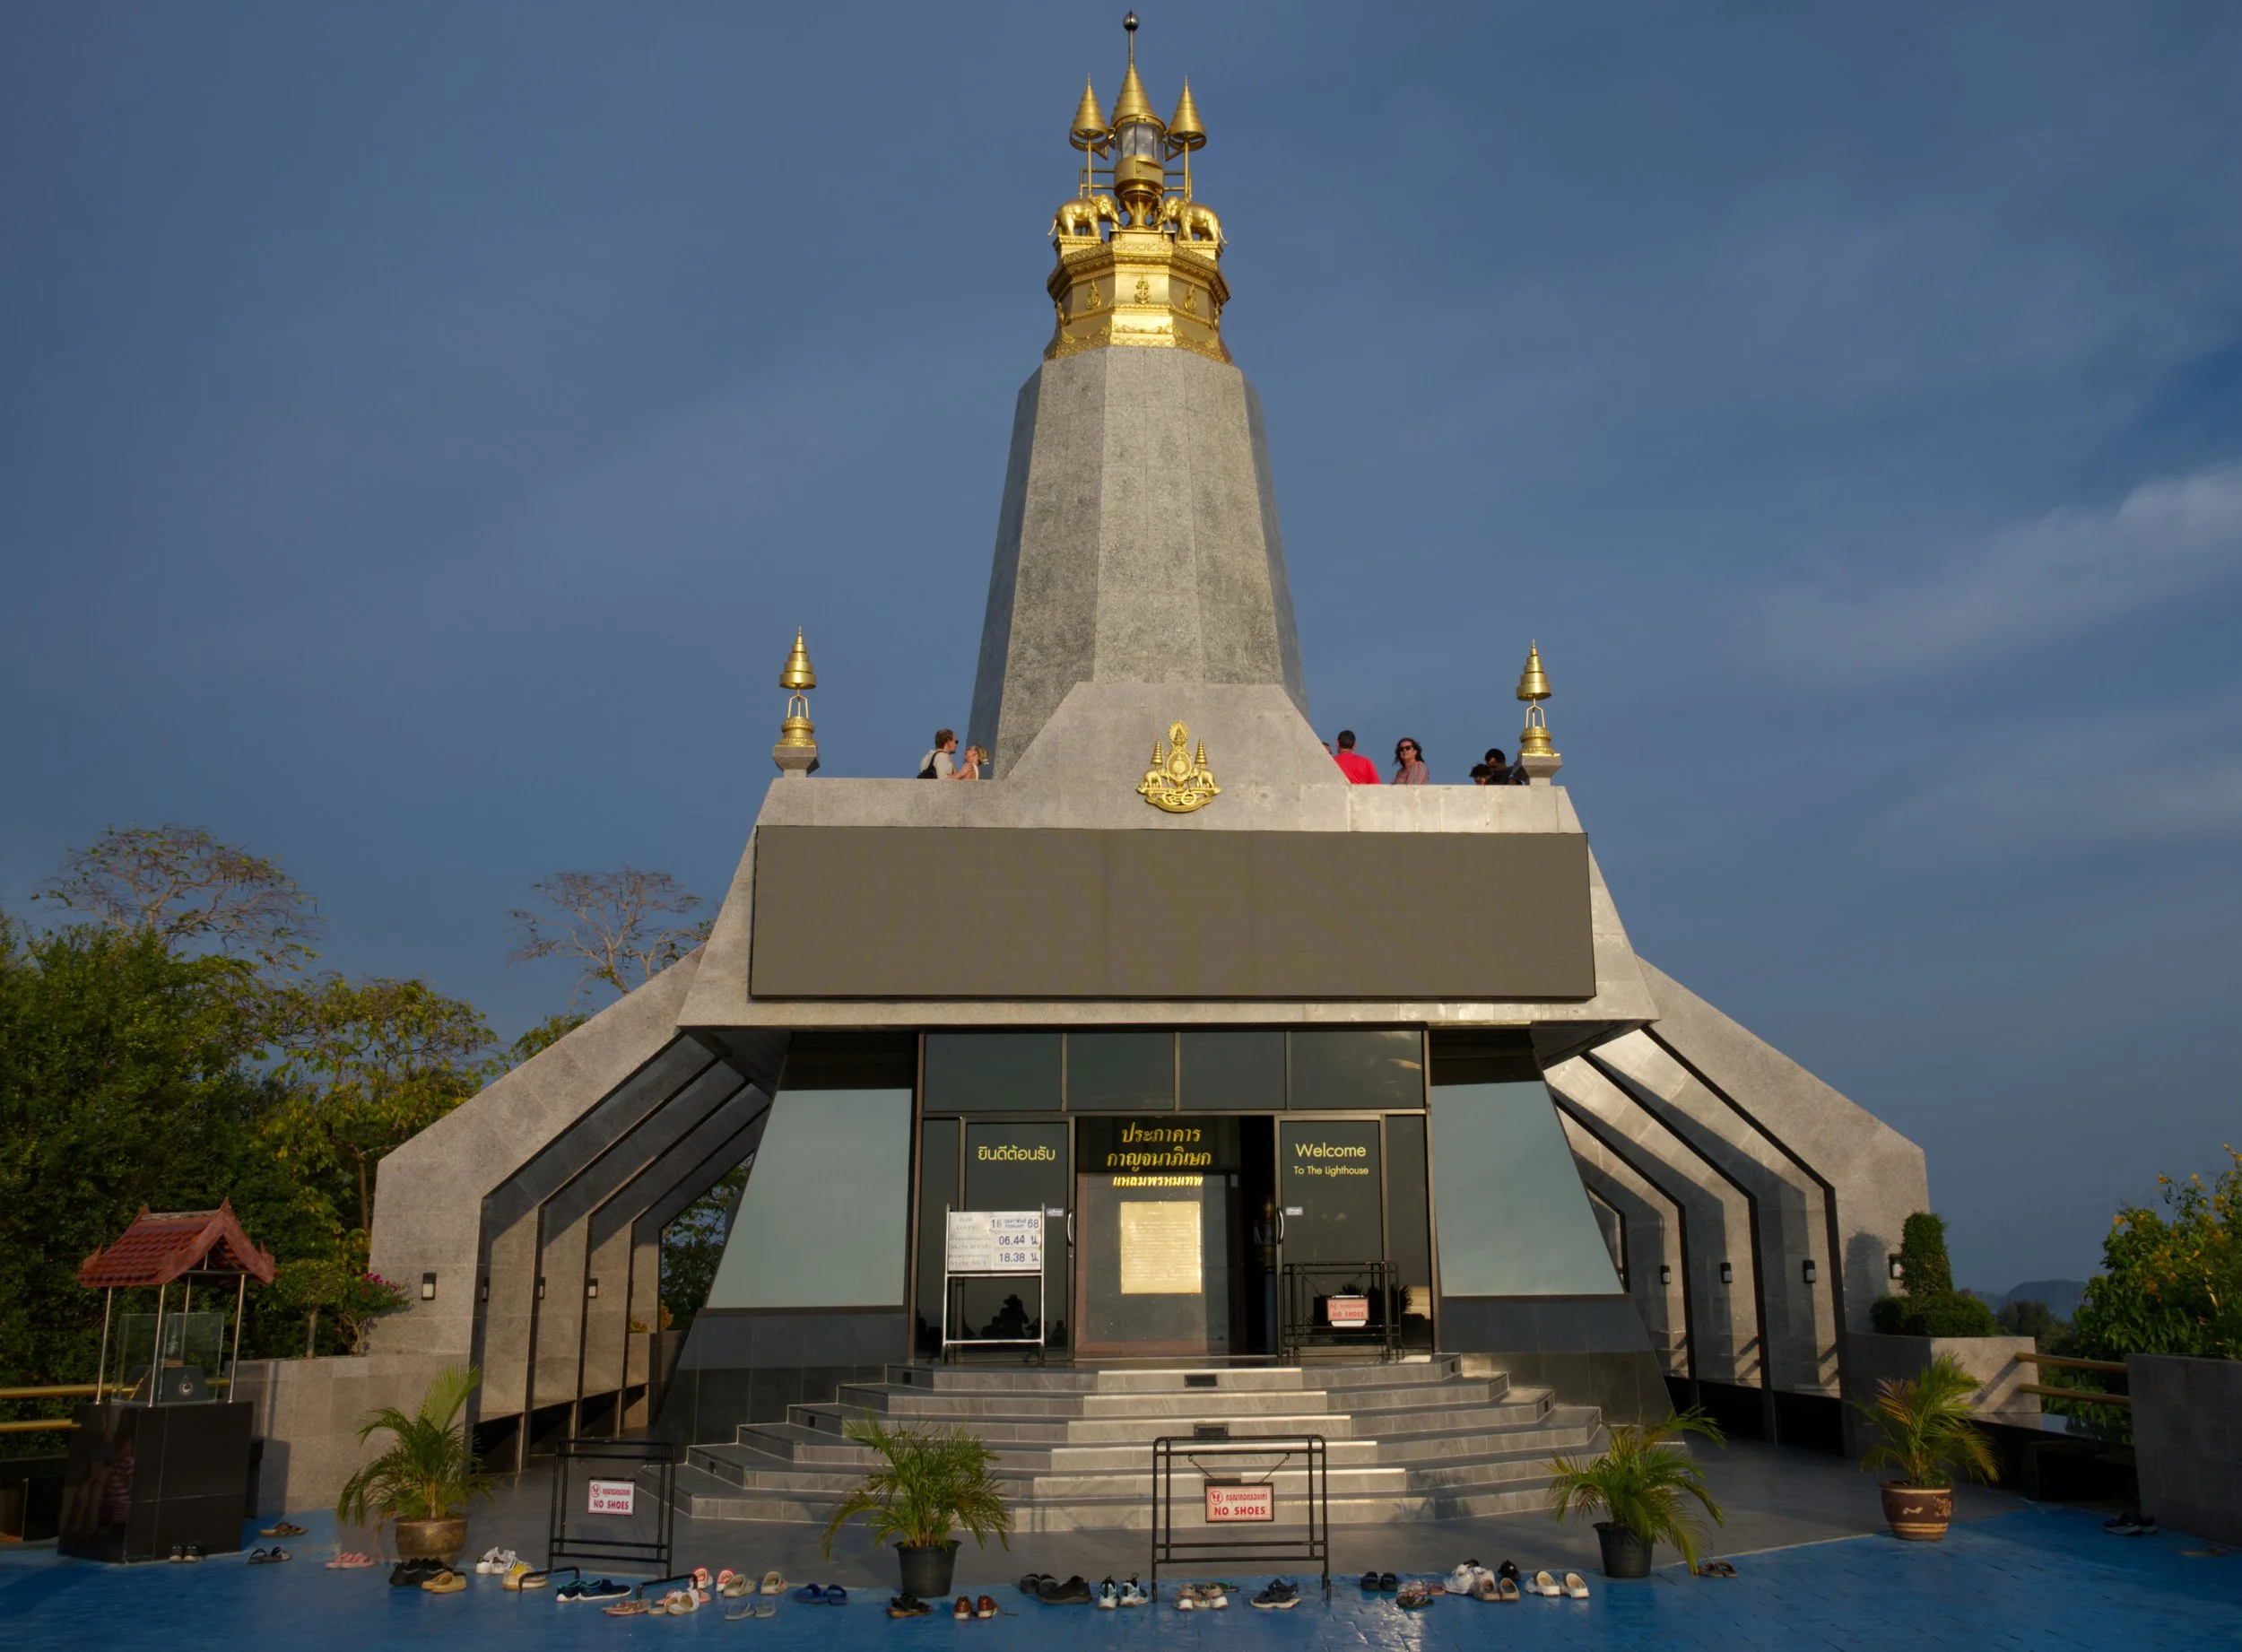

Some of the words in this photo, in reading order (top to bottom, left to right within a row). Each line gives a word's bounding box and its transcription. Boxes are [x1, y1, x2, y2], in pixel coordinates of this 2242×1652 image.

[1122, 1121, 1202, 1143] ประภาคาร
[978, 1144, 1056, 1161] ยินดีต้อนรับ
[1295, 1142, 1367, 1157] Welcome
[1107, 1145, 1212, 1172] กาญจนาภิเษก
[1293, 1166, 1305, 1175] To
[1307, 1165, 1323, 1175] The
[1325, 1165, 1369, 1178] Lighthouse
[1112, 1176, 1204, 1187] แหลมพรหมเทพ
[991, 1219, 1002, 1229] 16
[1027, 1219, 1039, 1229] 68
[998, 1236, 1025, 1245] 06.44
[999, 1253, 1025, 1262] 18.38
[593, 1500, 604, 1509] NO
[607, 1500, 629, 1509] SHOES
[1214, 1507, 1230, 1516] NO
[1234, 1506, 1266, 1516] SHOES
